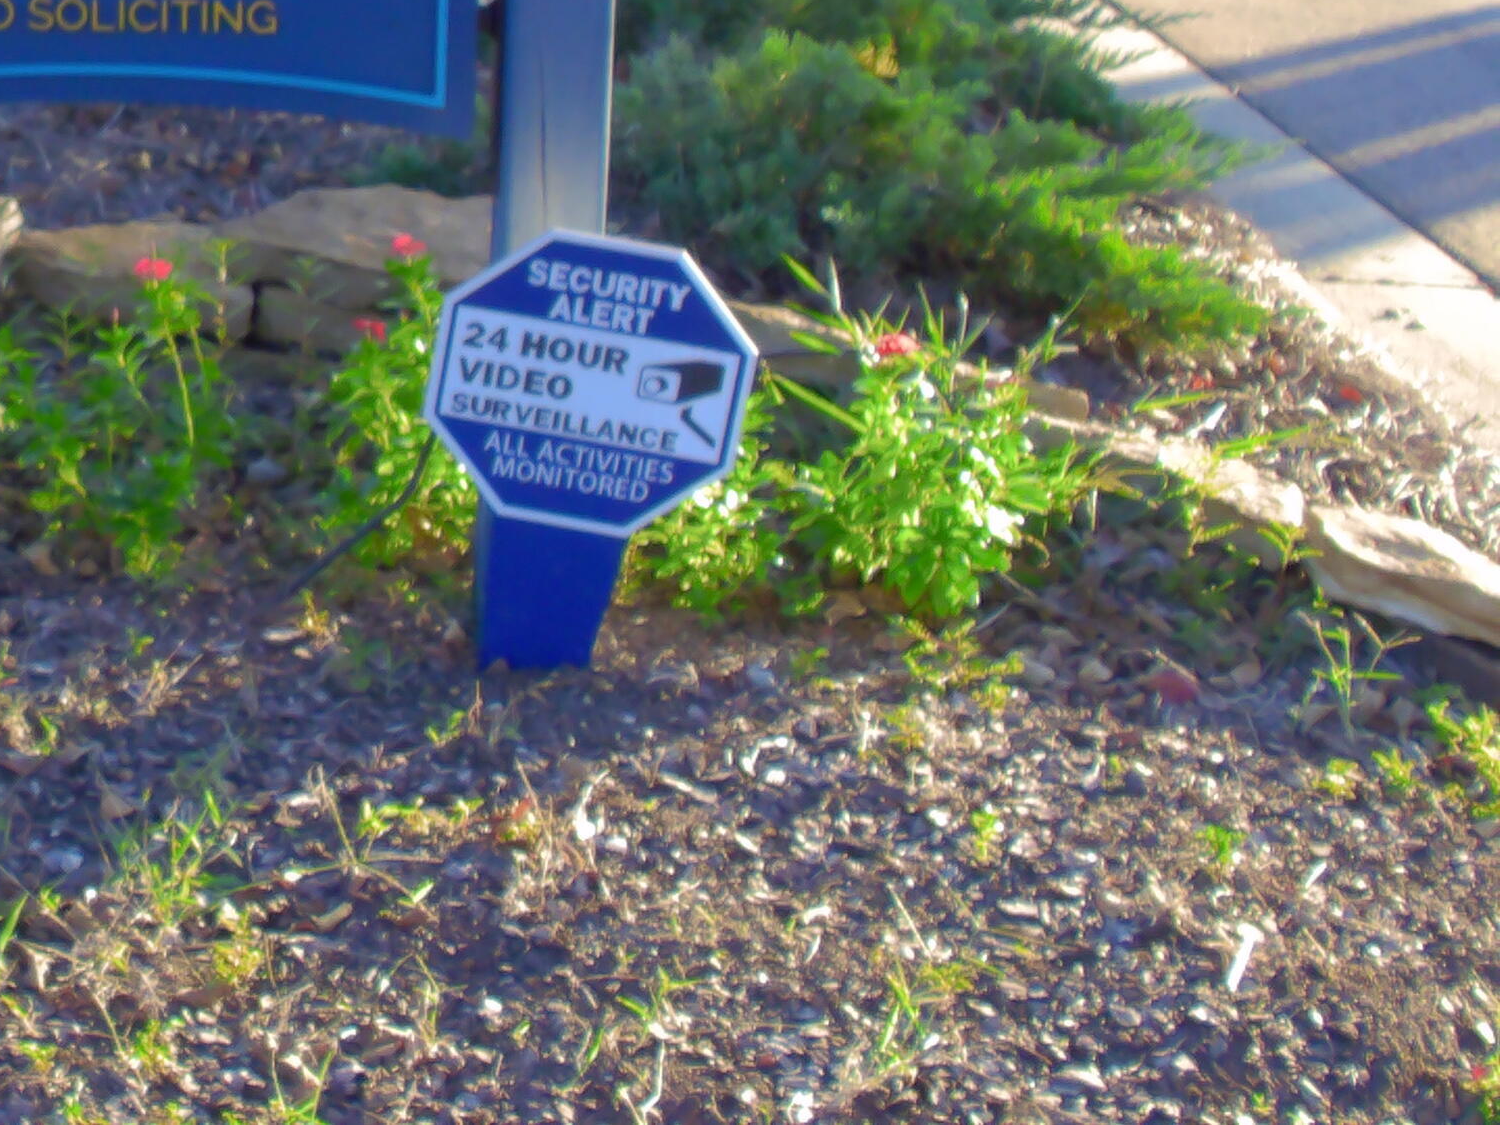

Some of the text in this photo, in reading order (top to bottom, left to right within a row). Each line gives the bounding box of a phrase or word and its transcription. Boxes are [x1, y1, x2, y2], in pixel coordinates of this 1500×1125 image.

[527, 258, 691, 313] SECURITY
[549, 293, 655, 336] ALERT
[463, 322, 631, 375] 24 HOUR
[459, 356, 574, 400] VIDEO
[451, 393, 680, 453] SURVEILLANCE
[484, 430, 675, 485] ALL ACTIVITIES
[493, 457, 648, 503] MONITORED
